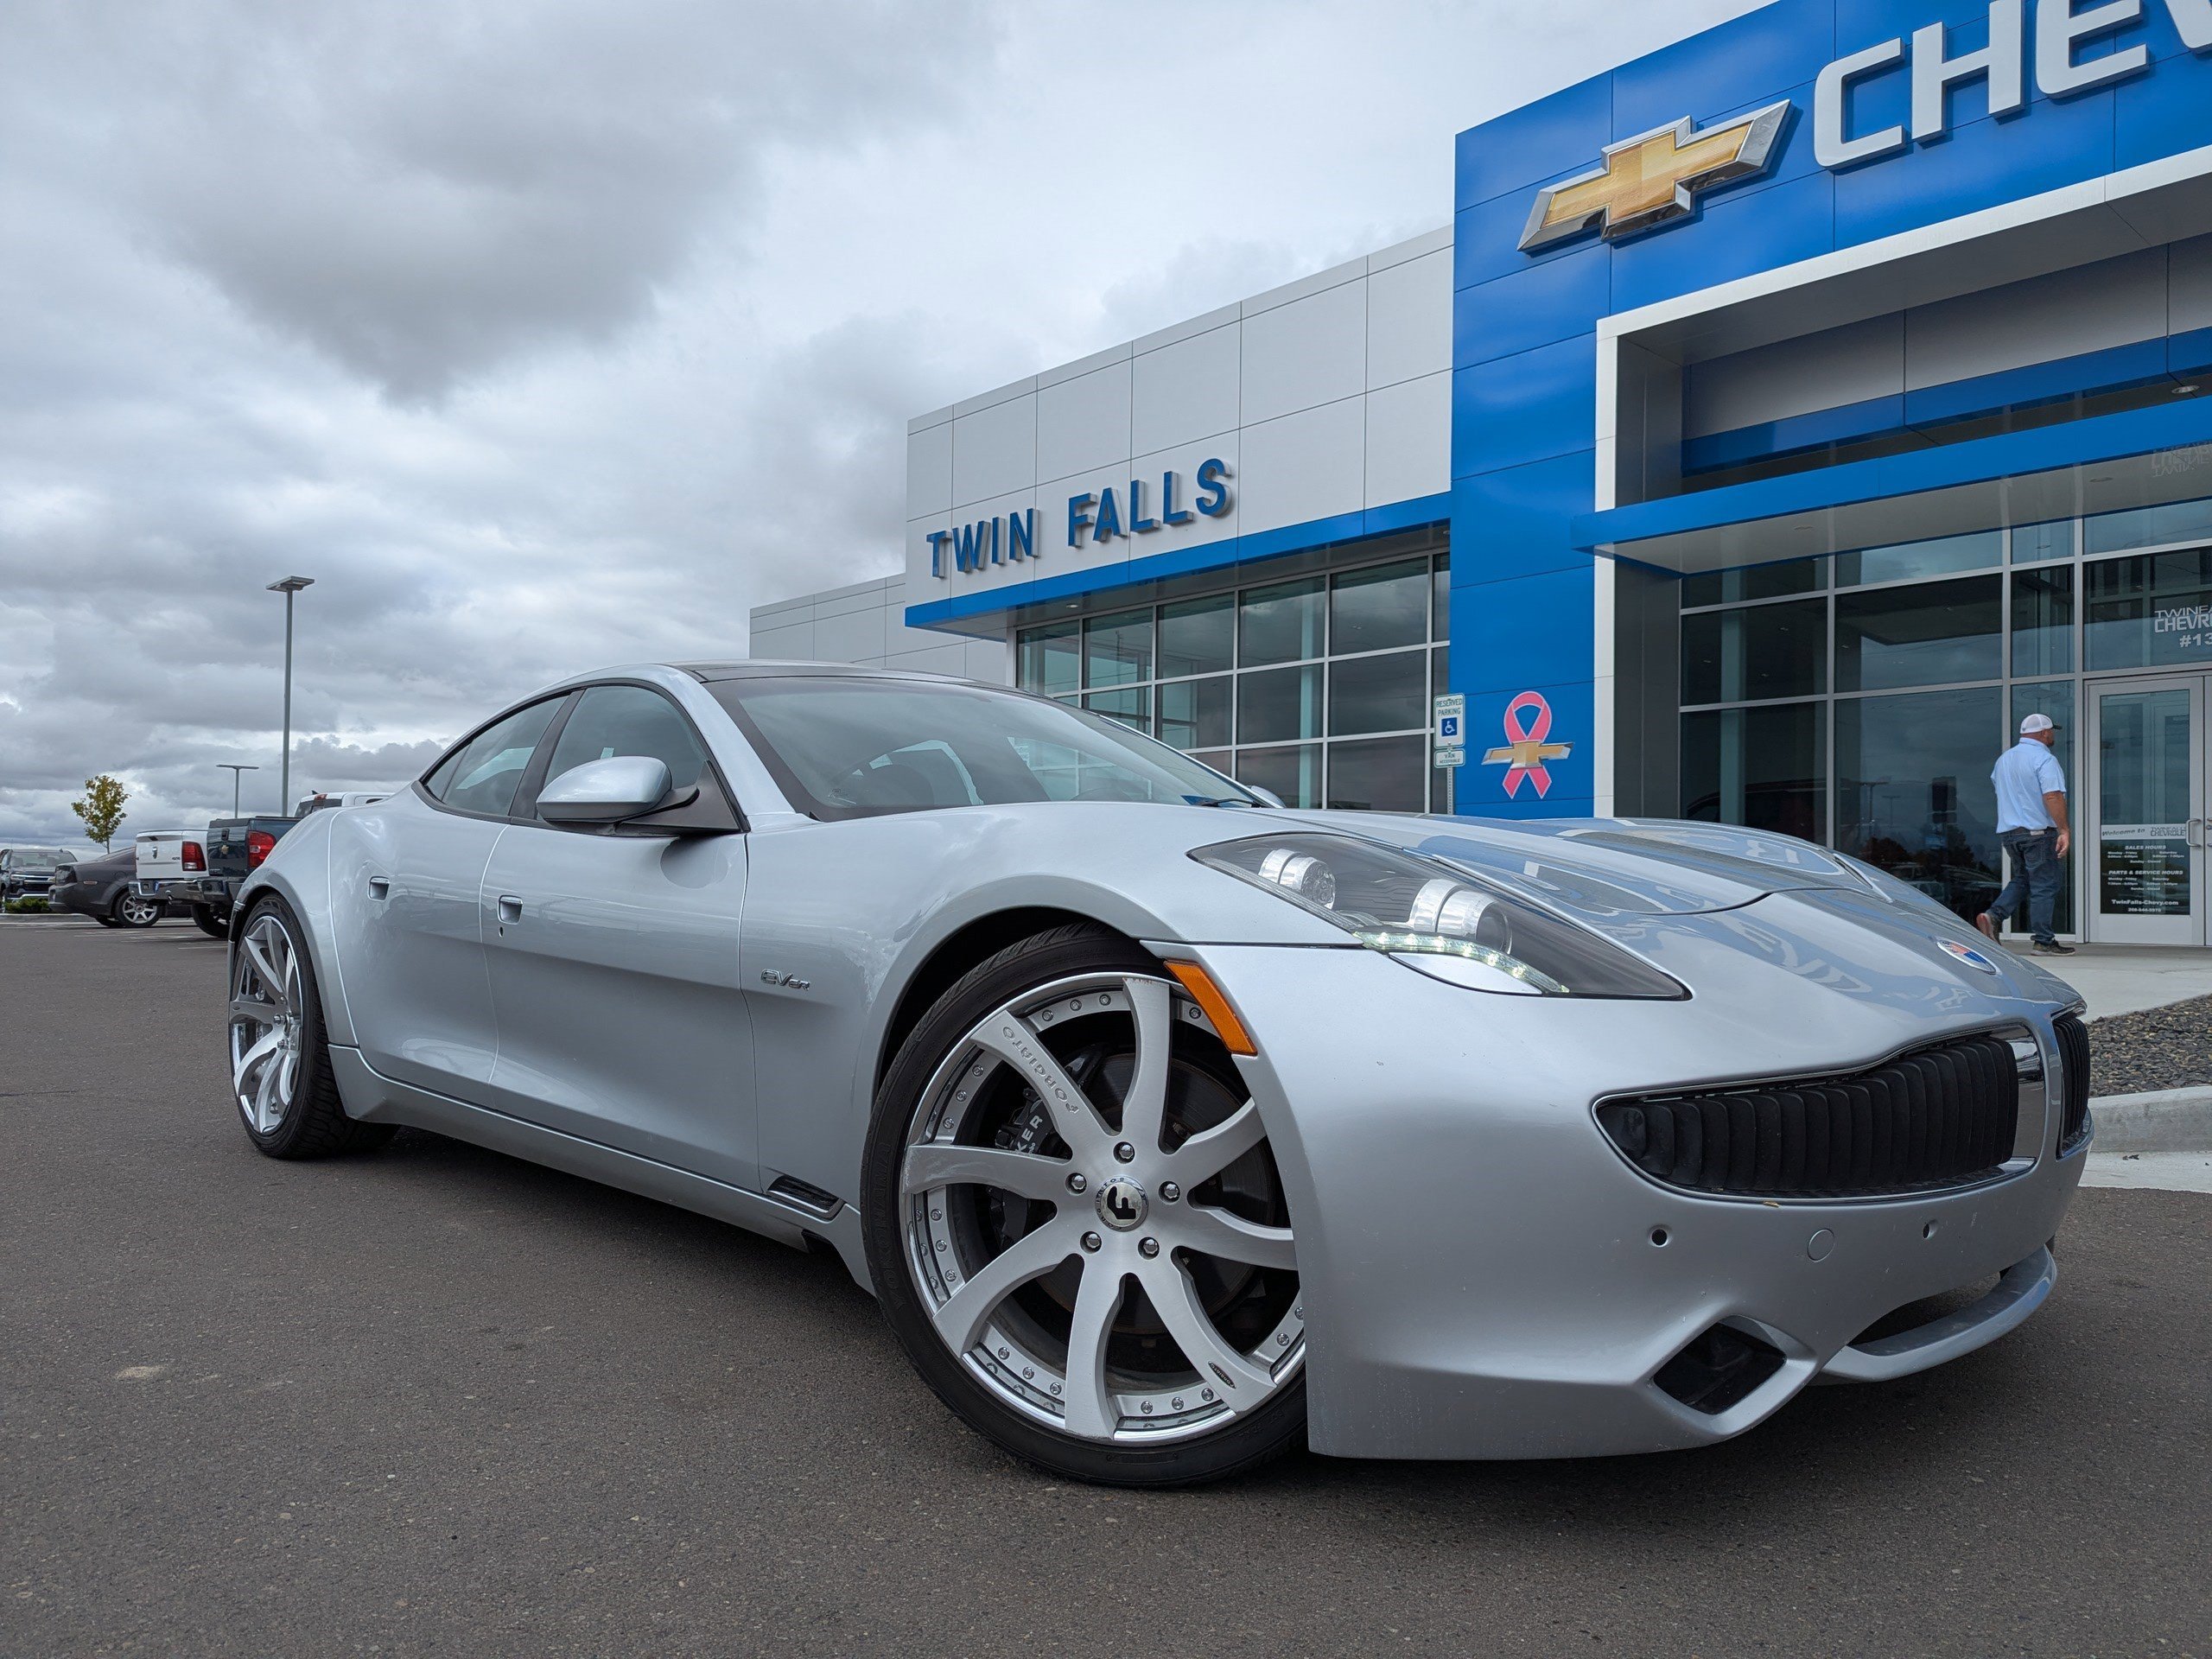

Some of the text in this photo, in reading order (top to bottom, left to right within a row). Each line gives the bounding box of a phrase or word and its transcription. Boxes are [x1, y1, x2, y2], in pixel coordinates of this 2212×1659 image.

[926, 459, 1232, 579] TWIN FALLS
[2154, 613, 2212, 632] CHEVR
[1436, 698, 1462, 708] RESERVED
[1438, 708, 1460, 716] PARKING
[1003, 1027, 1079, 1114] FORGIATO
